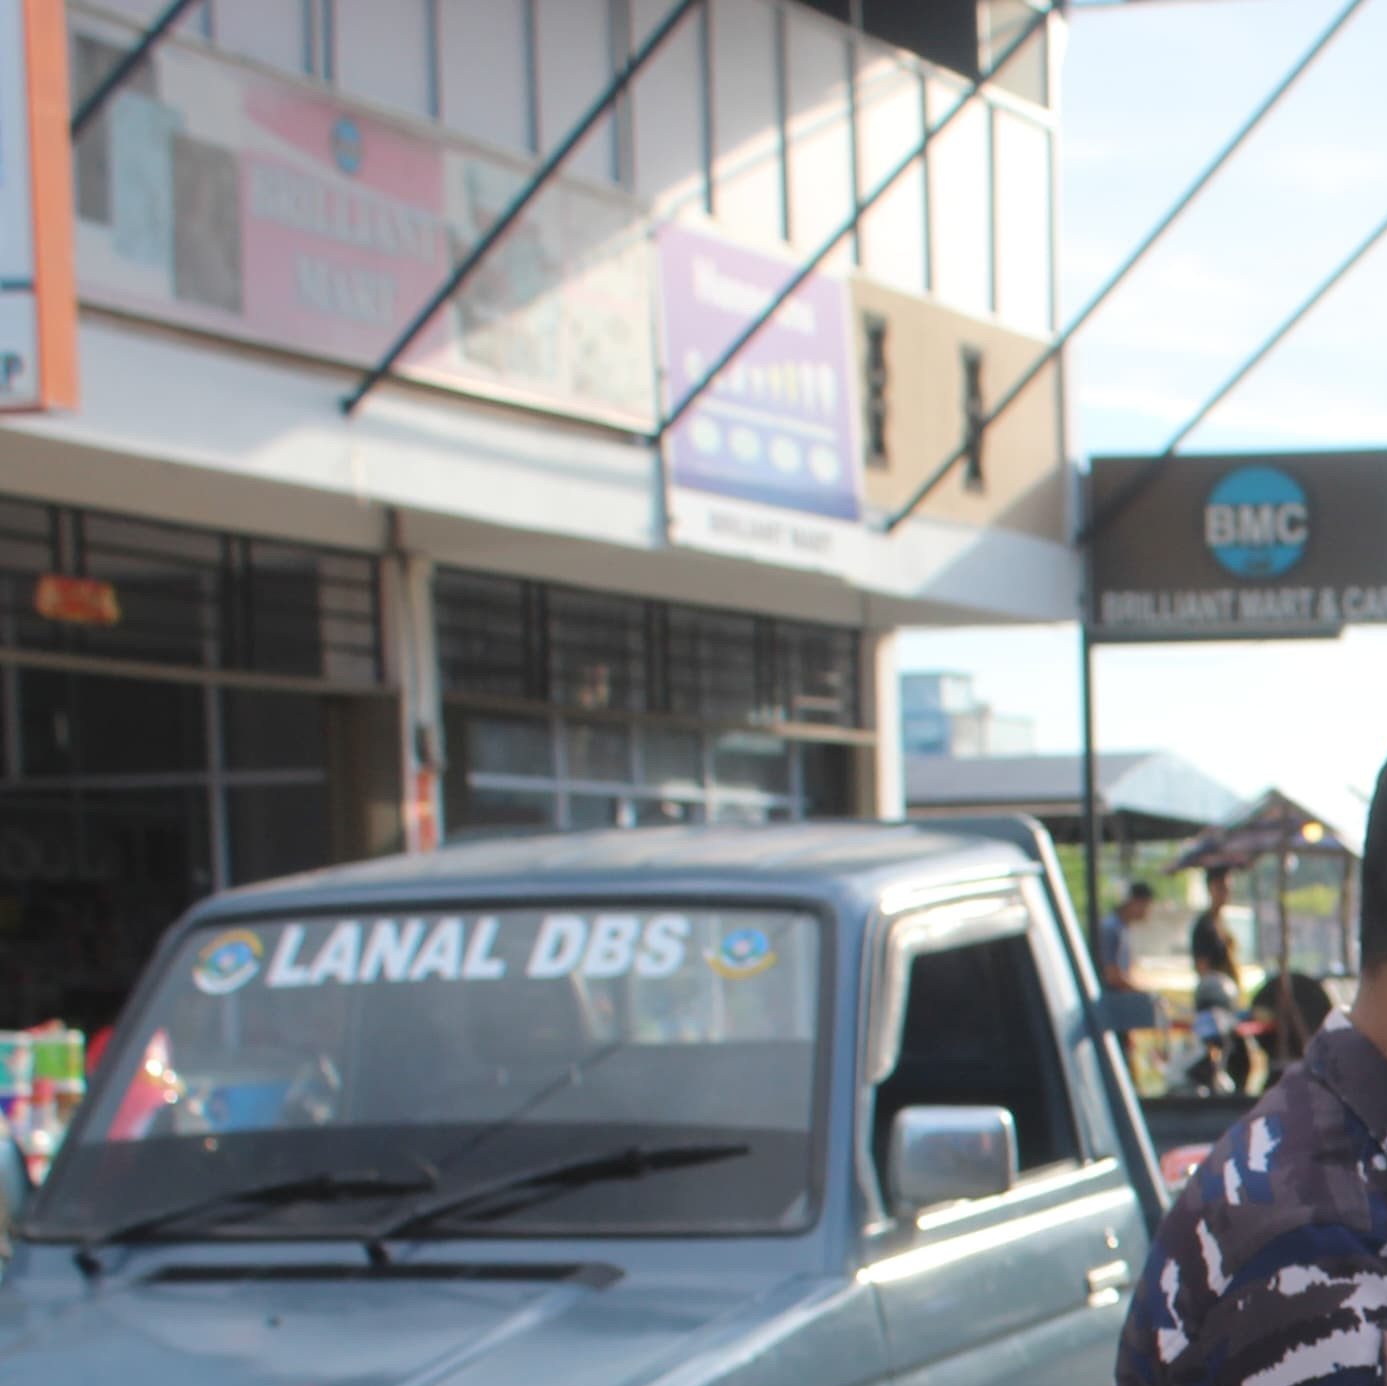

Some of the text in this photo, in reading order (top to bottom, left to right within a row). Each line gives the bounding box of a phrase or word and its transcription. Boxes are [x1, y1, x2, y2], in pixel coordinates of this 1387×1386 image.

[1204, 502, 1308, 546] BMC
[1101, 589, 1233, 626] BRILLIANT
[1239, 586, 1315, 622] MART
[1317, 585, 1339, 620] &
[265, 913, 691, 987] LANAL DBS
